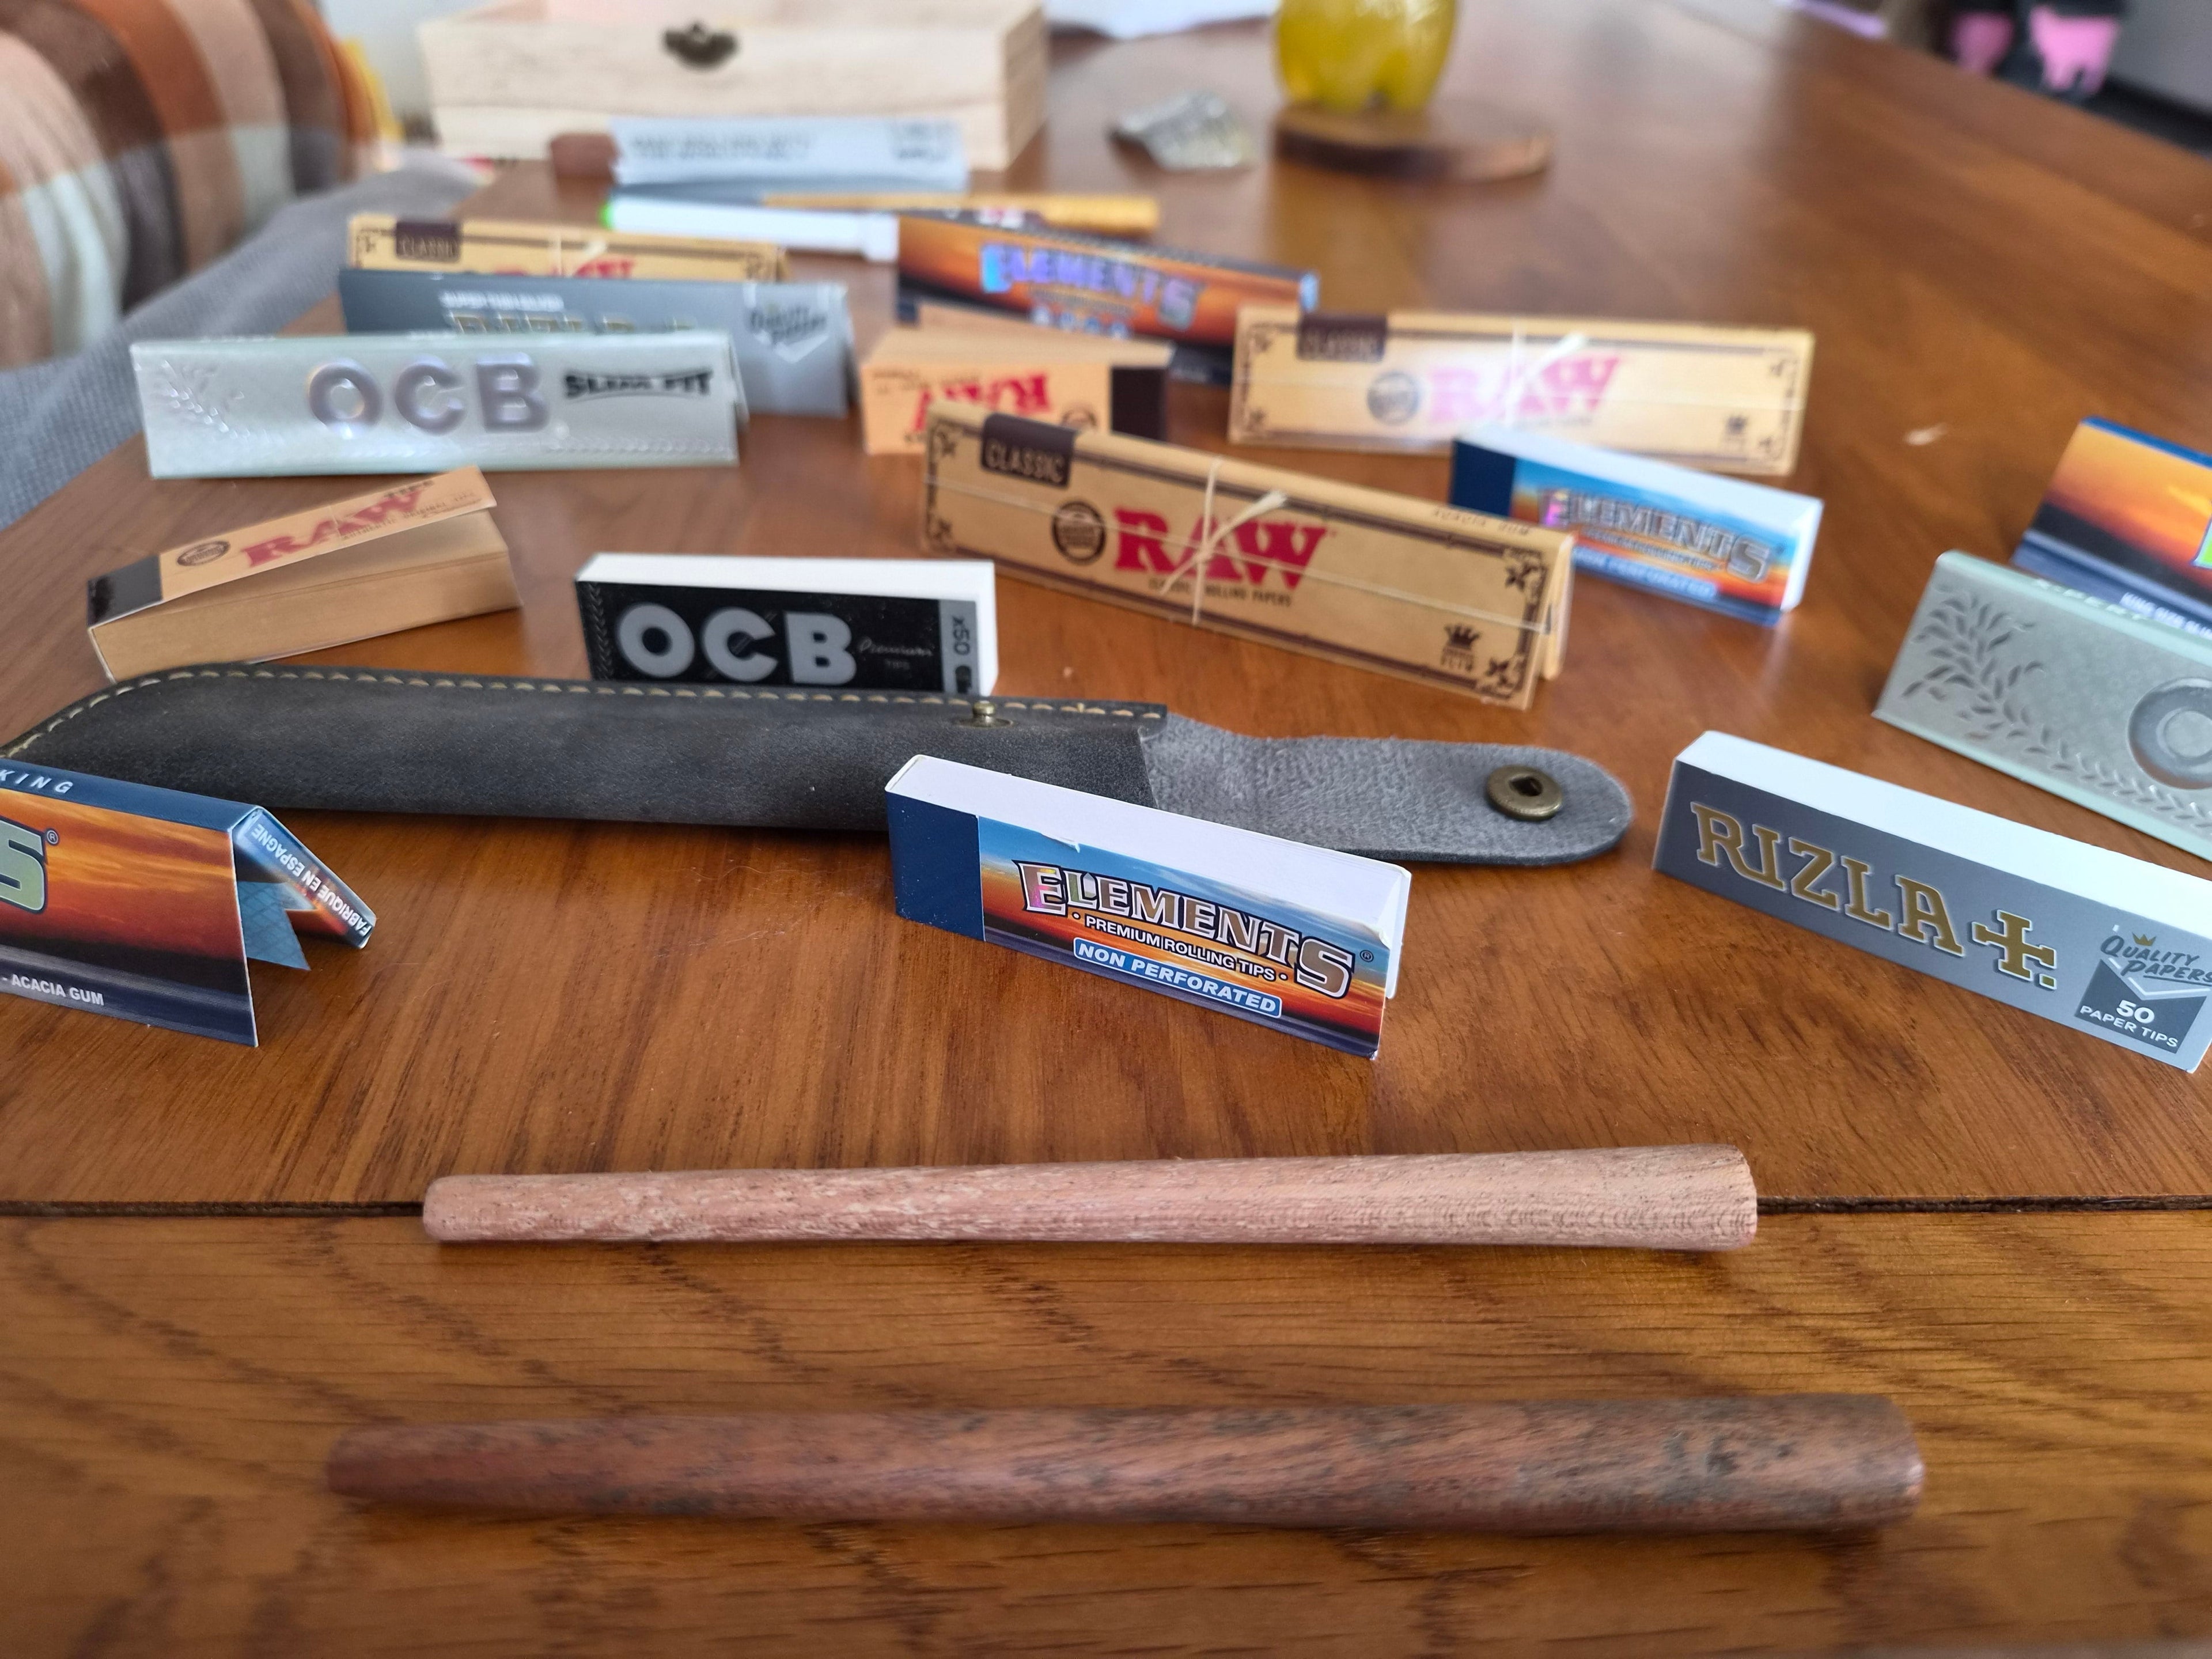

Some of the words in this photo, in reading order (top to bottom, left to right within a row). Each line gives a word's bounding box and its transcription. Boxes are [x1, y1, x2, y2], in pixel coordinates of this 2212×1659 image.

[307, 352, 550, 437] OCB
[985, 440, 1063, 483] CLASSIC
[240, 488, 424, 567] RAW
[1113, 507, 1327, 591] RAW
[1539, 487, 1773, 583] ELEMENTS
[616, 602, 857, 685] OCB
[0, 769, 74, 794] KING
[251, 824, 305, 877] ESPAGNE
[301, 870, 322, 892] EN
[317, 885, 372, 937] FABRIQUE
[1012, 859, 1356, 1000] ELEMENTS
[1085, 914, 1164, 948] PREMIUM
[1164, 938, 1236, 969] ROLLING
[1238, 959, 1276, 981] TIPS
[2100, 935, 2200, 966] QUALITY
[12, 974, 67, 998] ACACIA
[69, 986, 105, 1006] GUM
[1078, 942, 1124, 968] NON
[1131, 959, 1277, 1013] PERFORATED
[2080, 1005, 2137, 1033] PAPER
[2141, 1026, 2179, 1048] TIPS
[2116, 999, 2155, 1024] 50
